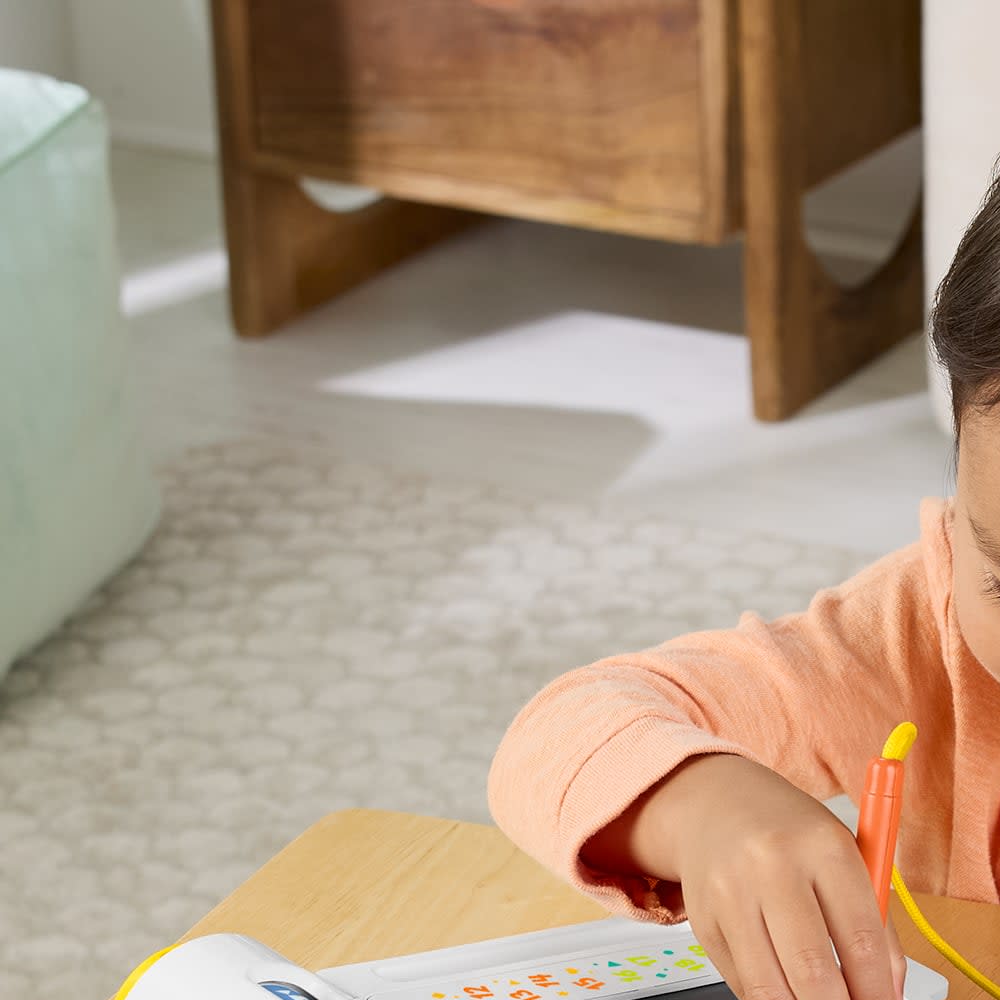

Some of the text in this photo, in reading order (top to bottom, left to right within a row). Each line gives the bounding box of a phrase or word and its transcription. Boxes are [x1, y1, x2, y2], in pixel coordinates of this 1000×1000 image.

[625, 956, 657, 967] 17
[674, 959, 705, 971] 18
[527, 974, 560, 988] 14
[612, 970, 643, 982] 16
[573, 978, 605, 990] 15
[463, 986, 494, 999] 12
